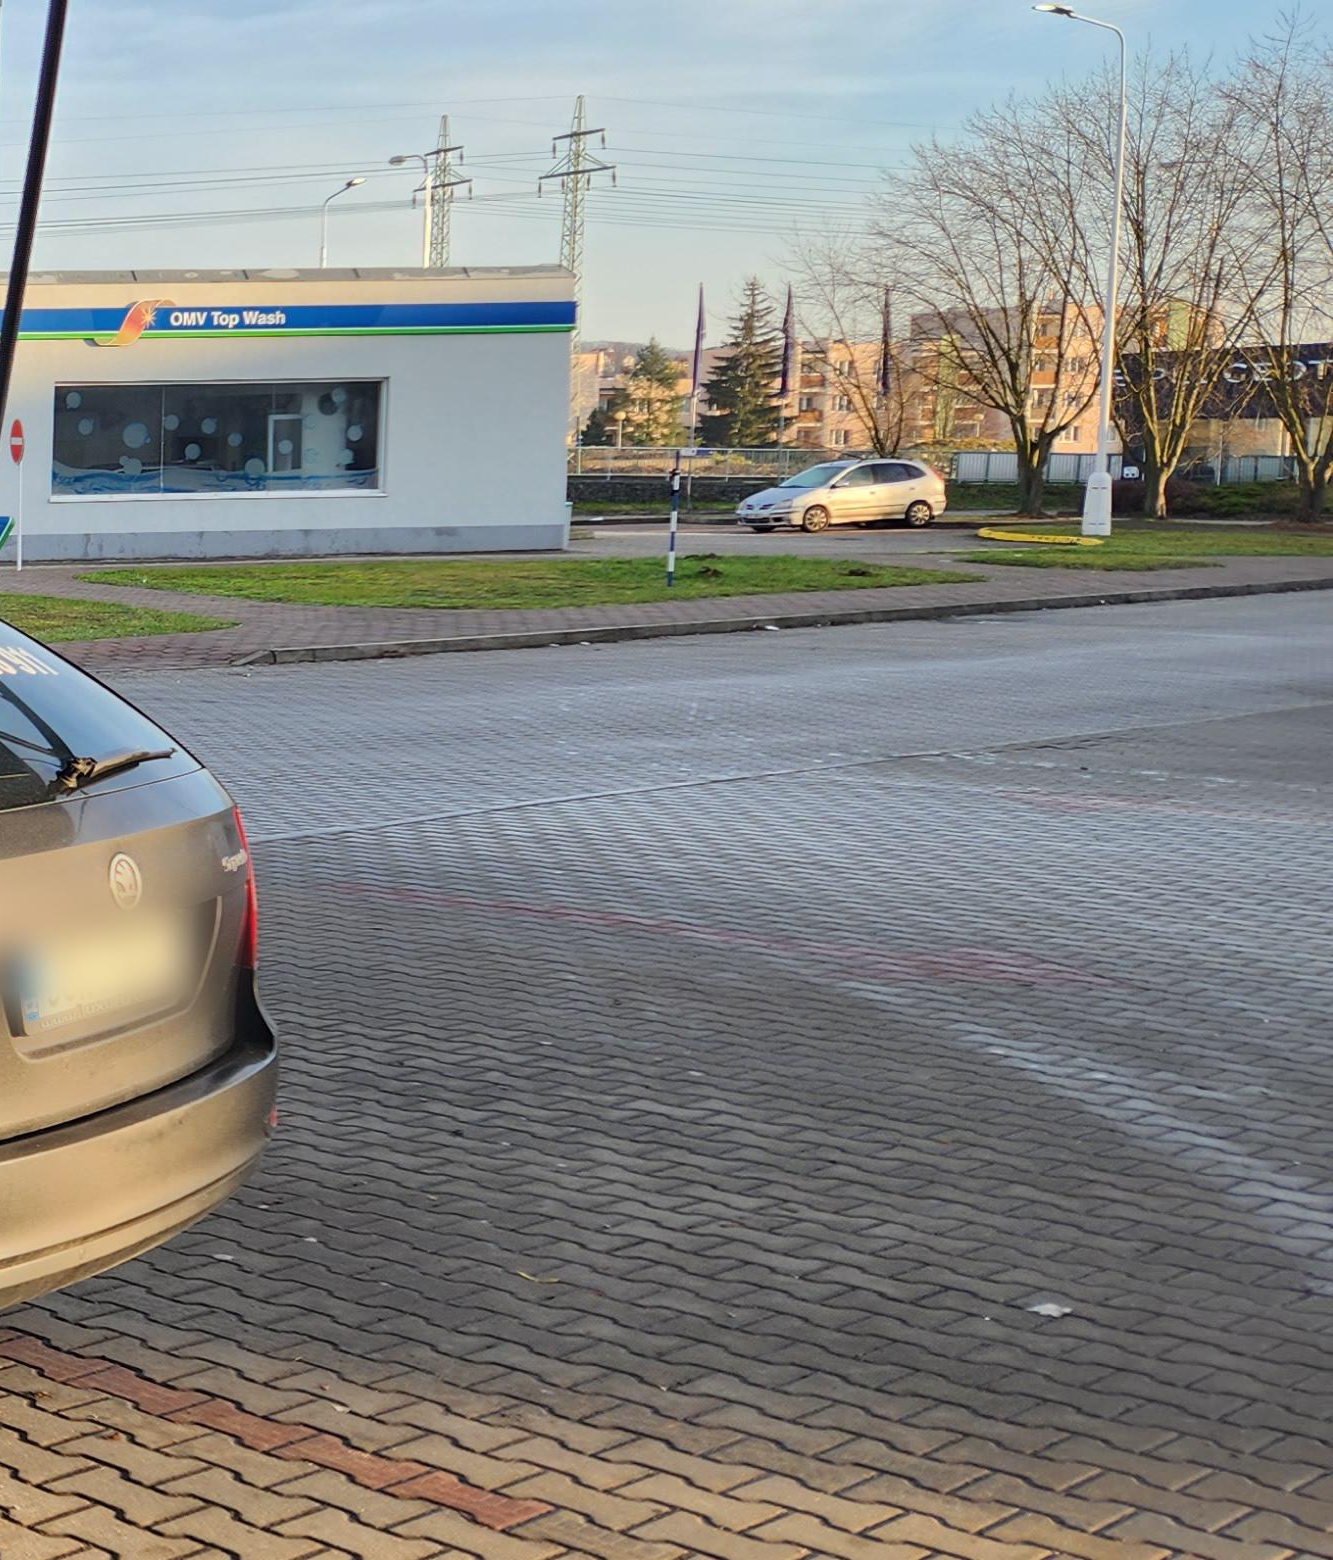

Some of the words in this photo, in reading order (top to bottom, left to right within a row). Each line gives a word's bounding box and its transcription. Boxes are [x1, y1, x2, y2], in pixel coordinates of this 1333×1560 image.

[169, 311, 208, 327] OMV
[211, 311, 240, 329] Top
[242, 310, 287, 326] Wash
